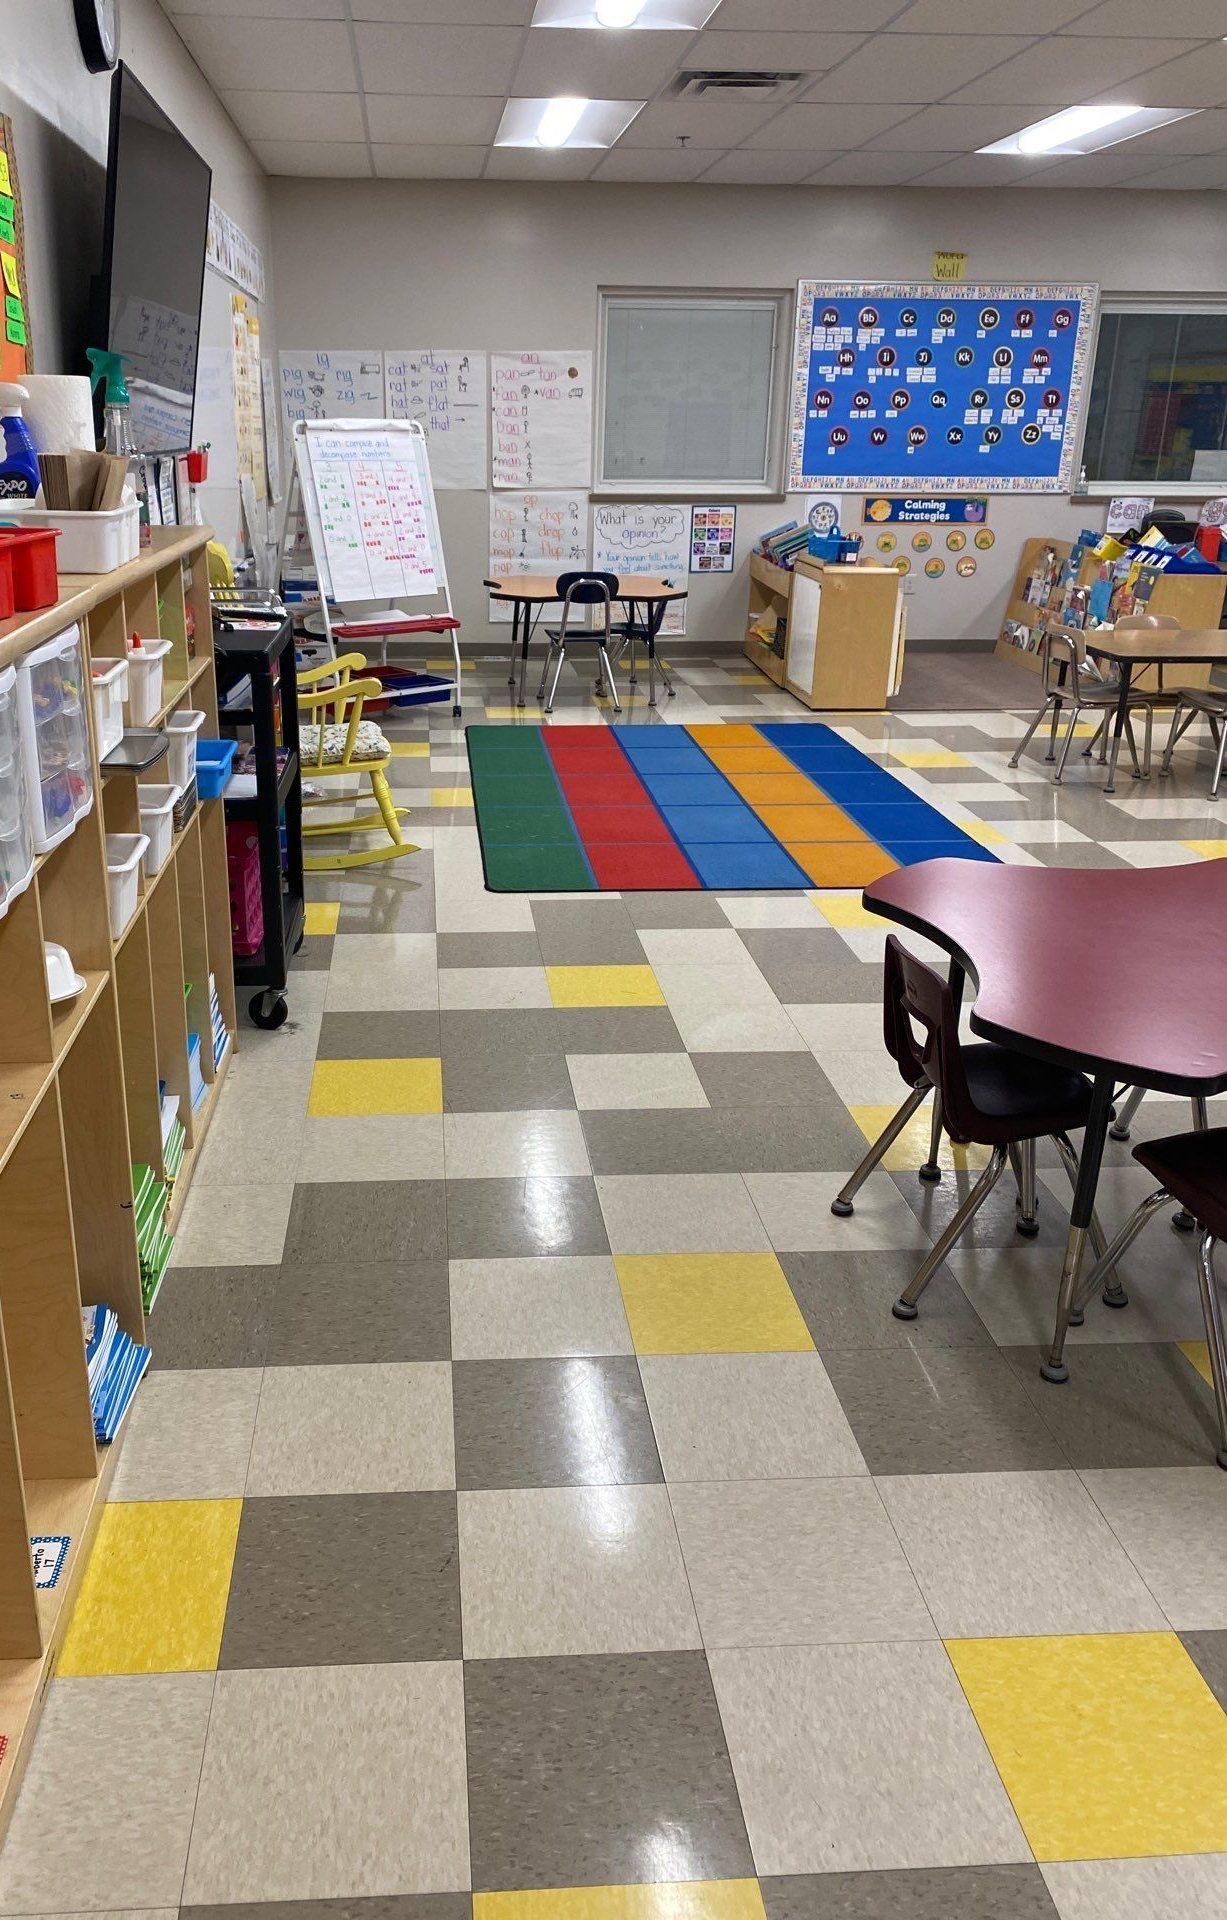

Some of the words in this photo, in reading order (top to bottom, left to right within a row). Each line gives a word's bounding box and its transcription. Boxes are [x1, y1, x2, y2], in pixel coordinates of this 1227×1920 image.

[936, 263, 960, 278] Wall
[824, 314, 836, 322] Aa
[863, 313, 874, 322] Bb
[903, 314, 914, 323] Cc
[940, 313, 953, 322] Dd
[984, 314, 995, 323] Ee
[1020, 314, 1030, 323] Ff
[1056, 315, 1069, 325] Gg
[521, 353, 540, 364] an
[840, 354, 853, 362] Hh
[883, 352, 890, 362] Ii
[919, 352, 928, 363] Jj
[958, 353, 970, 362] Kk
[1000, 353, 1007, 362] Ll
[1034, 354, 1048, 363] Mm
[388, 362, 408, 376] cat
[430, 361, 450, 375] sat
[283, 368, 303, 385] pig
[390, 378, 409, 392] rat
[430, 376, 448, 392] pat
[283, 389, 306, 404] wig
[337, 390, 355, 404] zig
[495, 385, 518, 401] fan
[540, 387, 561, 399] van
[391, 395, 409, 408] hat
[817, 396, 830, 404] Nn
[856, 396, 869, 405] Oo
[895, 396, 906, 406] Pp
[932, 395, 946, 406] Qq
[974, 395, 984, 403] Rr
[1011, 395, 1020, 403] Ss
[1048, 395, 1056, 403] Tt
[287, 404, 305, 420] big
[430, 416, 450, 431] that
[497, 421, 520, 435] Dan
[833, 433, 846, 441] Uu
[873, 433, 884, 441] Vv
[910, 433, 924, 441] Ww
[949, 432, 961, 440] Xx
[988, 431, 999, 441] Yy
[1026, 430, 1037, 439] Zz
[315, 437, 322, 448] I
[326, 440, 341, 448] can
[375, 438, 389, 448] and
[524, 495, 538, 508] op
[905, 500, 946, 511] Calming
[495, 503, 516, 525] hop
[539, 507, 564, 524] chop
[898, 511, 950, 522] Strategies
[1110, 504, 1150, 520] can
[600, 510, 627, 525] What
[634, 515, 644, 525] is
[652, 515, 677, 528] your
[493, 528, 514, 543] cop
[539, 524, 565, 542] drop
[493, 547, 515, 560] mop
[540, 540, 564, 560] flop
[606, 551, 620, 561] Your
[623, 554, 646, 564] opinion
[494, 562, 513, 575] pop
[43, 1559, 55, 1567] 17
